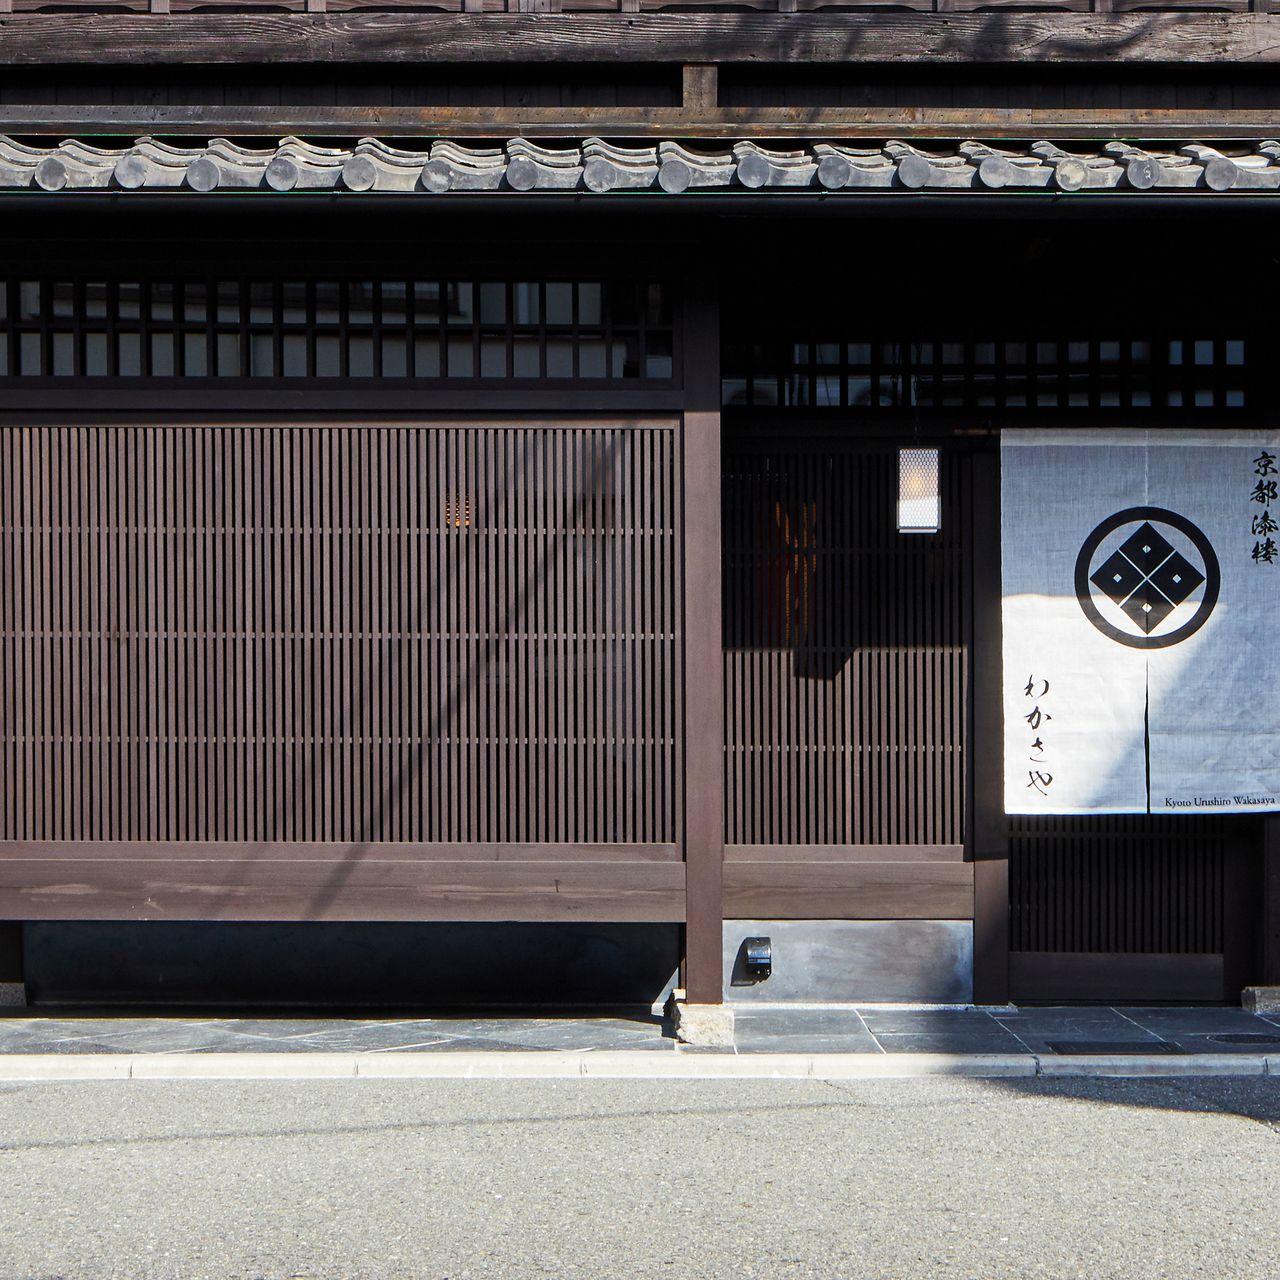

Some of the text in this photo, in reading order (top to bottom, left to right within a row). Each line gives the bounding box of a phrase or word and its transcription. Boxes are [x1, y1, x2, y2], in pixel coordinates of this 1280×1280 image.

[1023, 674, 1053, 796] わかさや
[1165, 796, 1275, 809] Kyoto Urushiro Wakasaya
